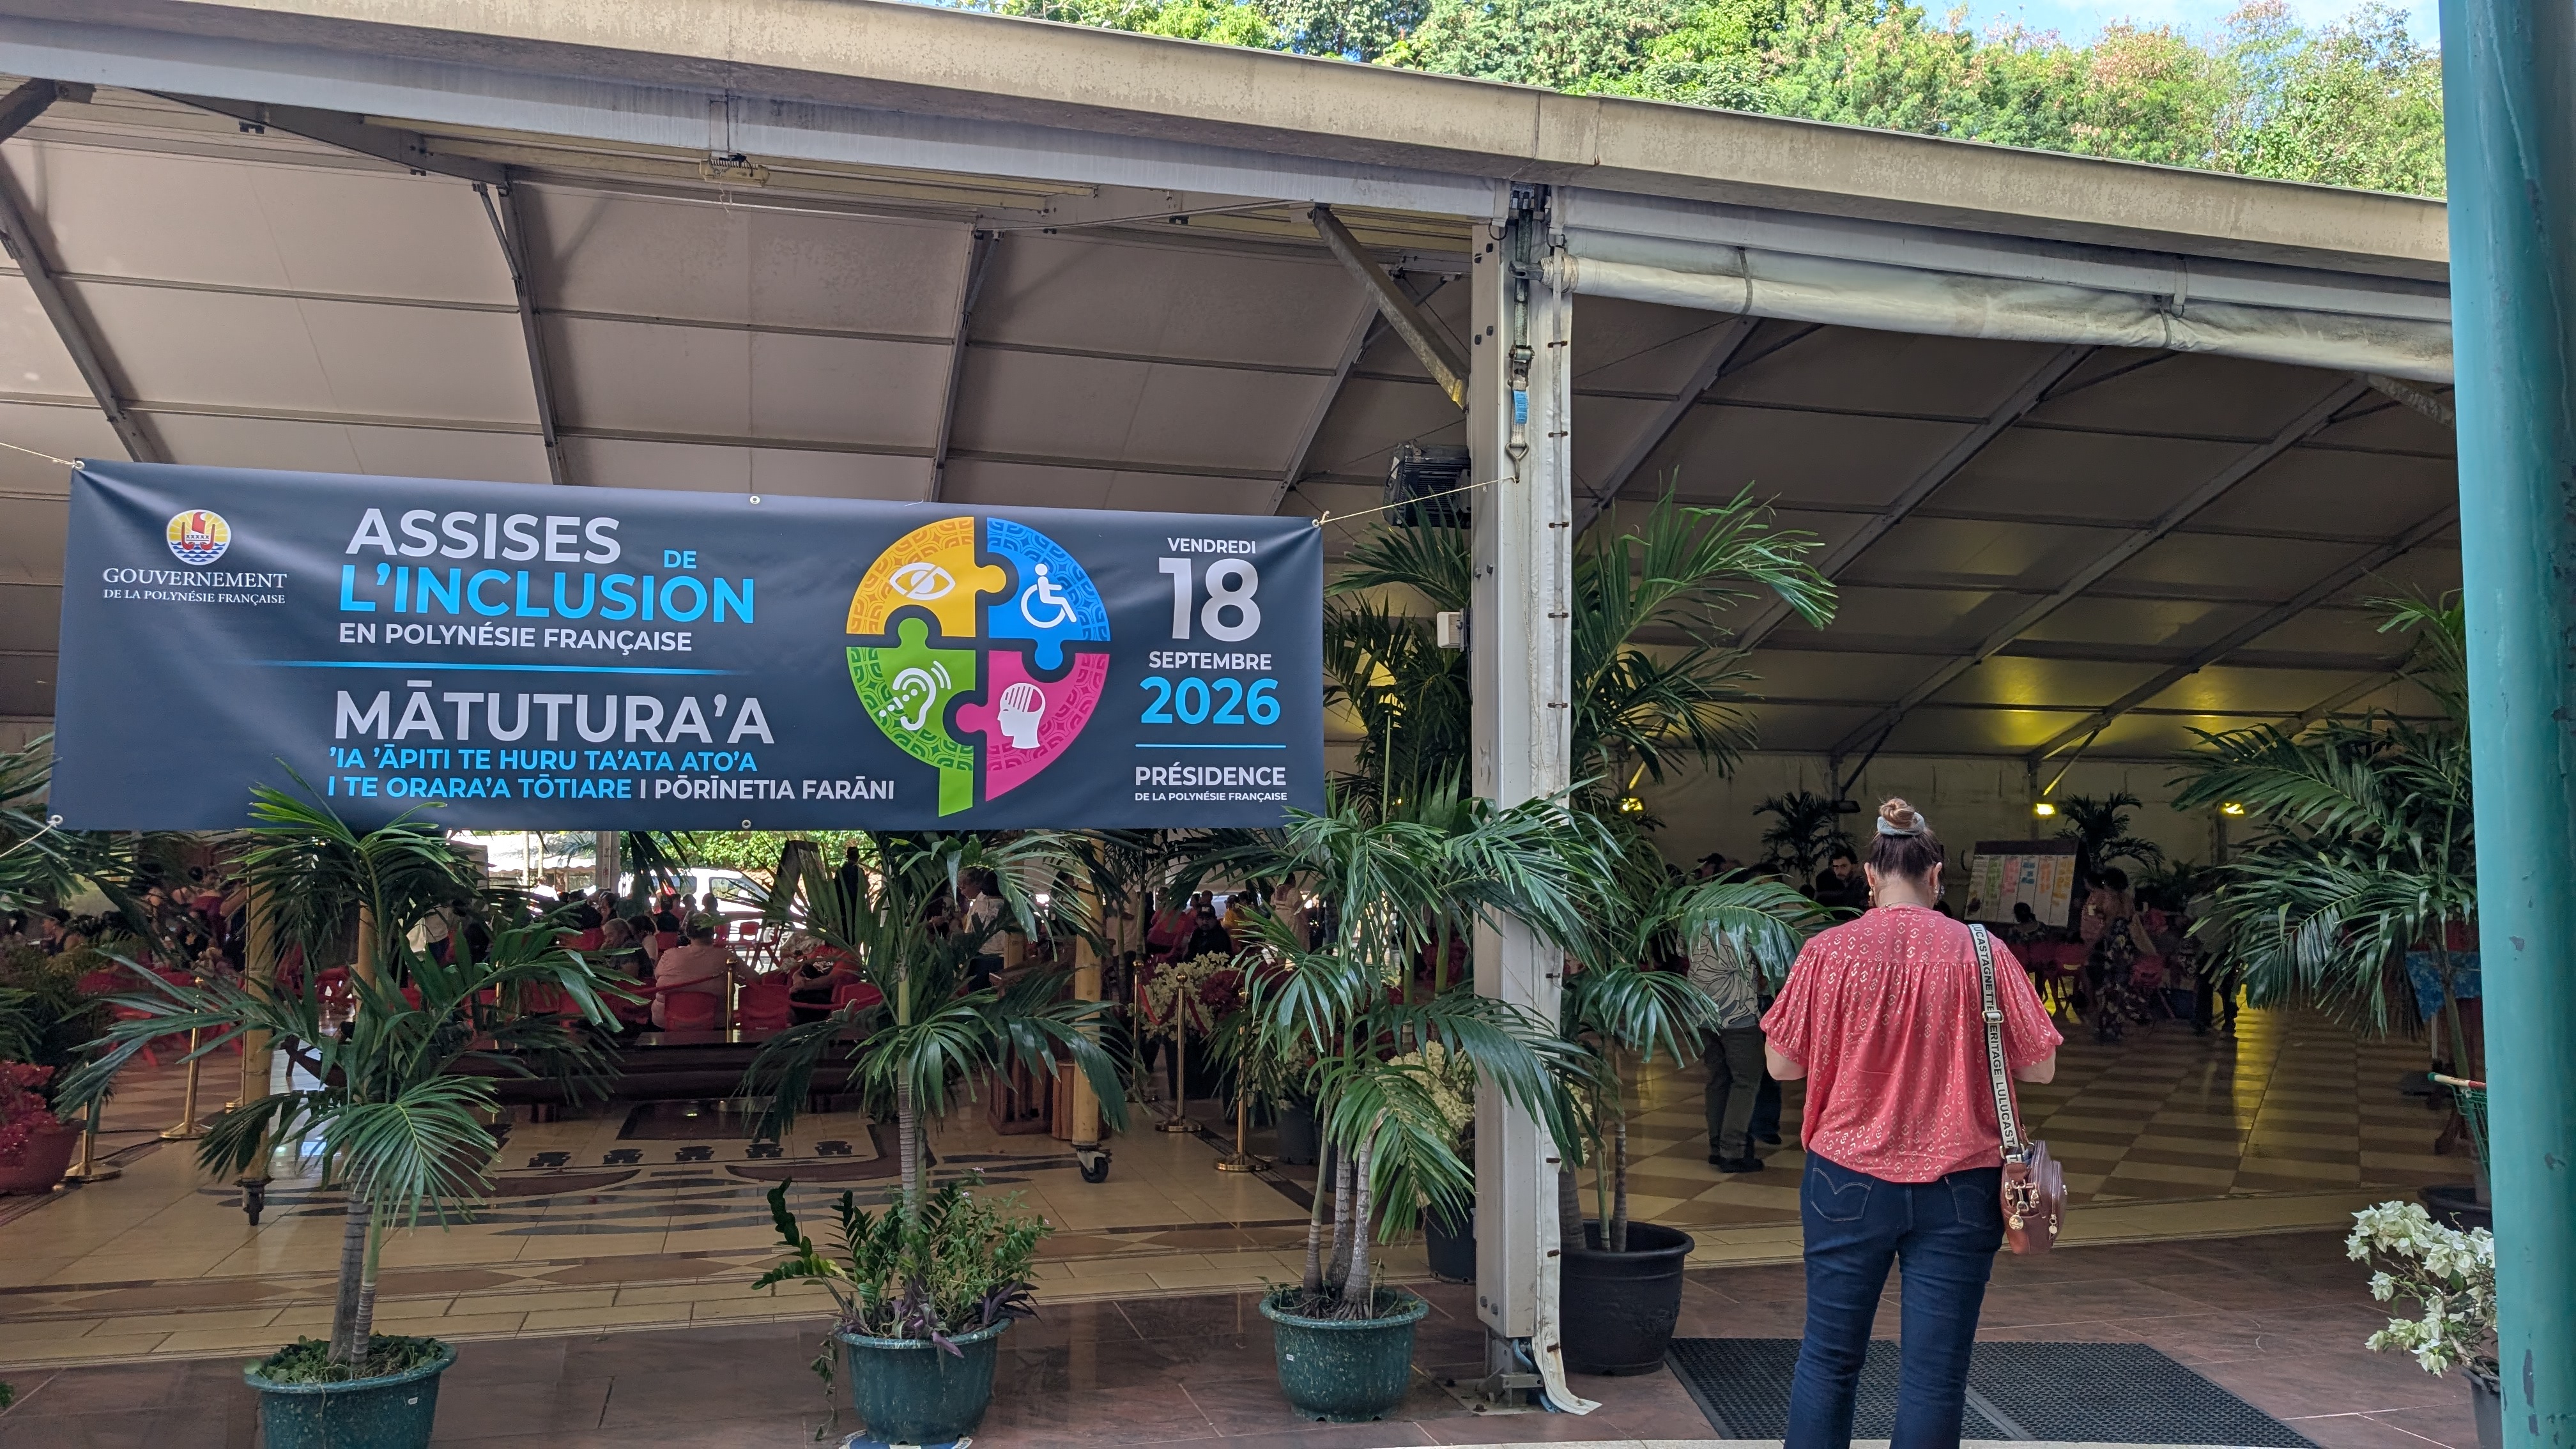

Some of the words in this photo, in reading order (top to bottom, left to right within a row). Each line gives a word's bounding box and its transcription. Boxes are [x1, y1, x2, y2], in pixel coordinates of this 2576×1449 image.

[345, 508, 621, 564] ASSISES
[1167, 537, 1256, 554] VENDREDI
[664, 549, 697, 569] DE
[103, 567, 288, 588] GOUVERNEMENT
[103, 589, 121, 599] DE
[125, 589, 141, 599] LA
[144, 590, 215, 602] POLYNÉSIE
[218, 593, 286, 606] FRANÇAISE
[340, 562, 755, 624] L’INCLUSION
[1158, 556, 1261, 642] 18
[339, 622, 376, 643] EN
[385, 621, 535, 647] POLYNÉSIE
[544, 628, 692, 656] FRANÇAISE
[1149, 651, 1272, 670] SEPTEMBRE
[335, 680, 775, 744] MĀTUTURA’A
[1140, 676, 1280, 725] 2026
[330, 746, 365, 769] ’IA
[458, 749, 491, 769] TE
[500, 749, 576, 770] HURU
[584, 749, 674, 771] TA’ATA
[680, 751, 758, 772] ATO’A
[328, 776, 335, 796] I
[343, 776, 378, 797] TE
[386, 776, 511, 798] ORARA’A
[518, 774, 632, 799] TŌTIARE
[655, 774, 795, 799] PŌRĪNETIA
[802, 776, 894, 799] FARĀNI
[1135, 762, 1287, 786] PRÉSIDENCE
[1135, 792, 1150, 801] DE
[1152, 792, 1167, 801] LA
[1169, 790, 1226, 801] POLYNÉSIE
[1229, 792, 1287, 803] FRANÇAISE
[1996, 1082, 2016, 1148] LULUCAST
